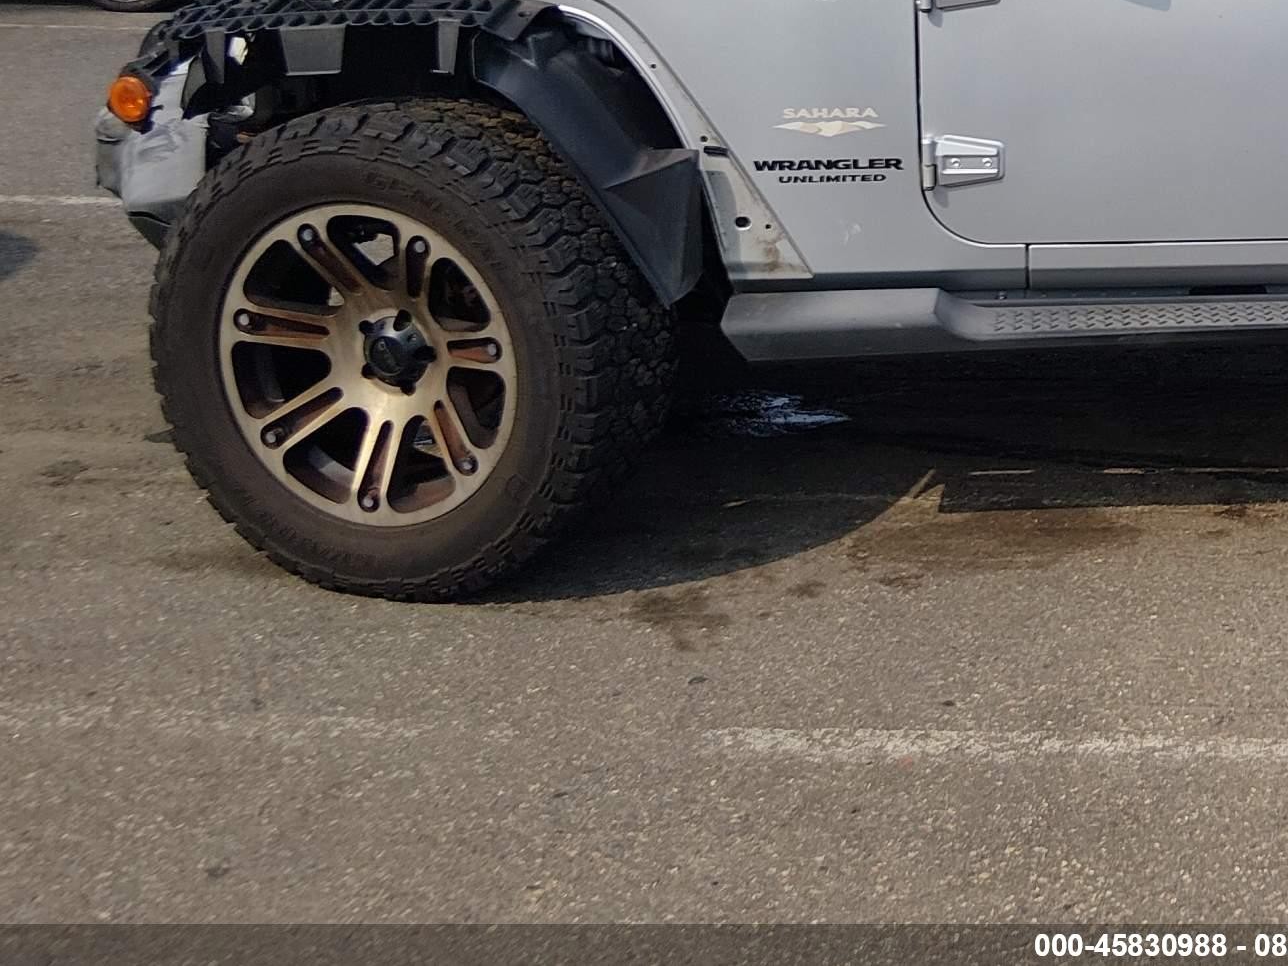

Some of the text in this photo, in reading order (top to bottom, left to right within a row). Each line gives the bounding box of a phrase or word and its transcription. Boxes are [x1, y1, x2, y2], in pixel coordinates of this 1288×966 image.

[783, 107, 879, 119] SAHARA
[753, 158, 905, 171] WRANGLER
[778, 173, 887, 184] UNLIMITED
